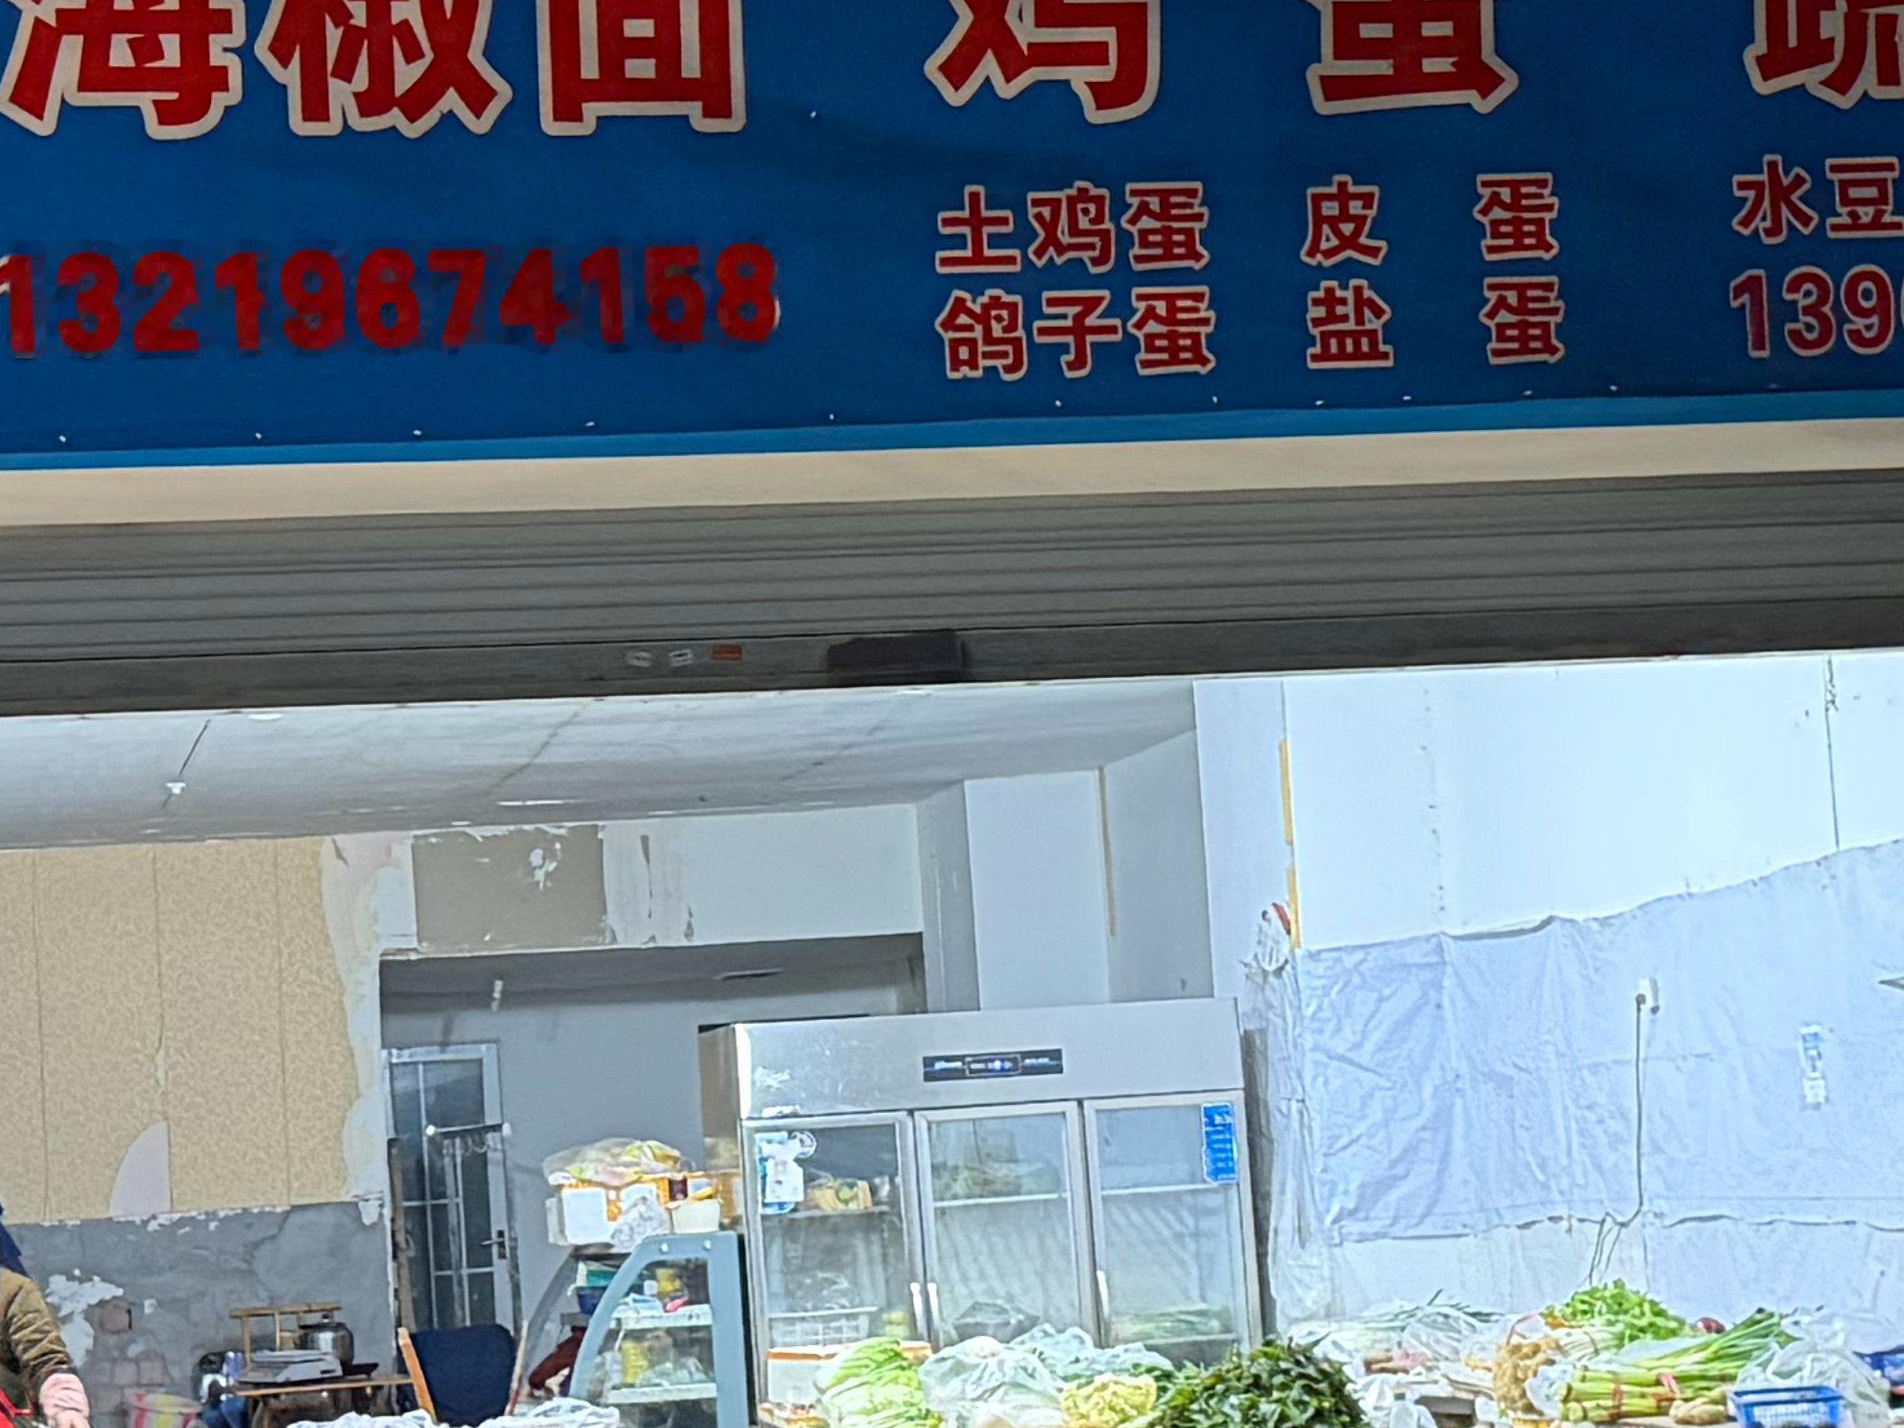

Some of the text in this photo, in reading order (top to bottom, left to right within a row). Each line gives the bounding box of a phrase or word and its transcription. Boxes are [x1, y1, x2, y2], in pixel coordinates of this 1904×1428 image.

[937, 181, 1209, 273] 土鸡蛋
[937, 285, 1216, 381] 鸽子蛋
